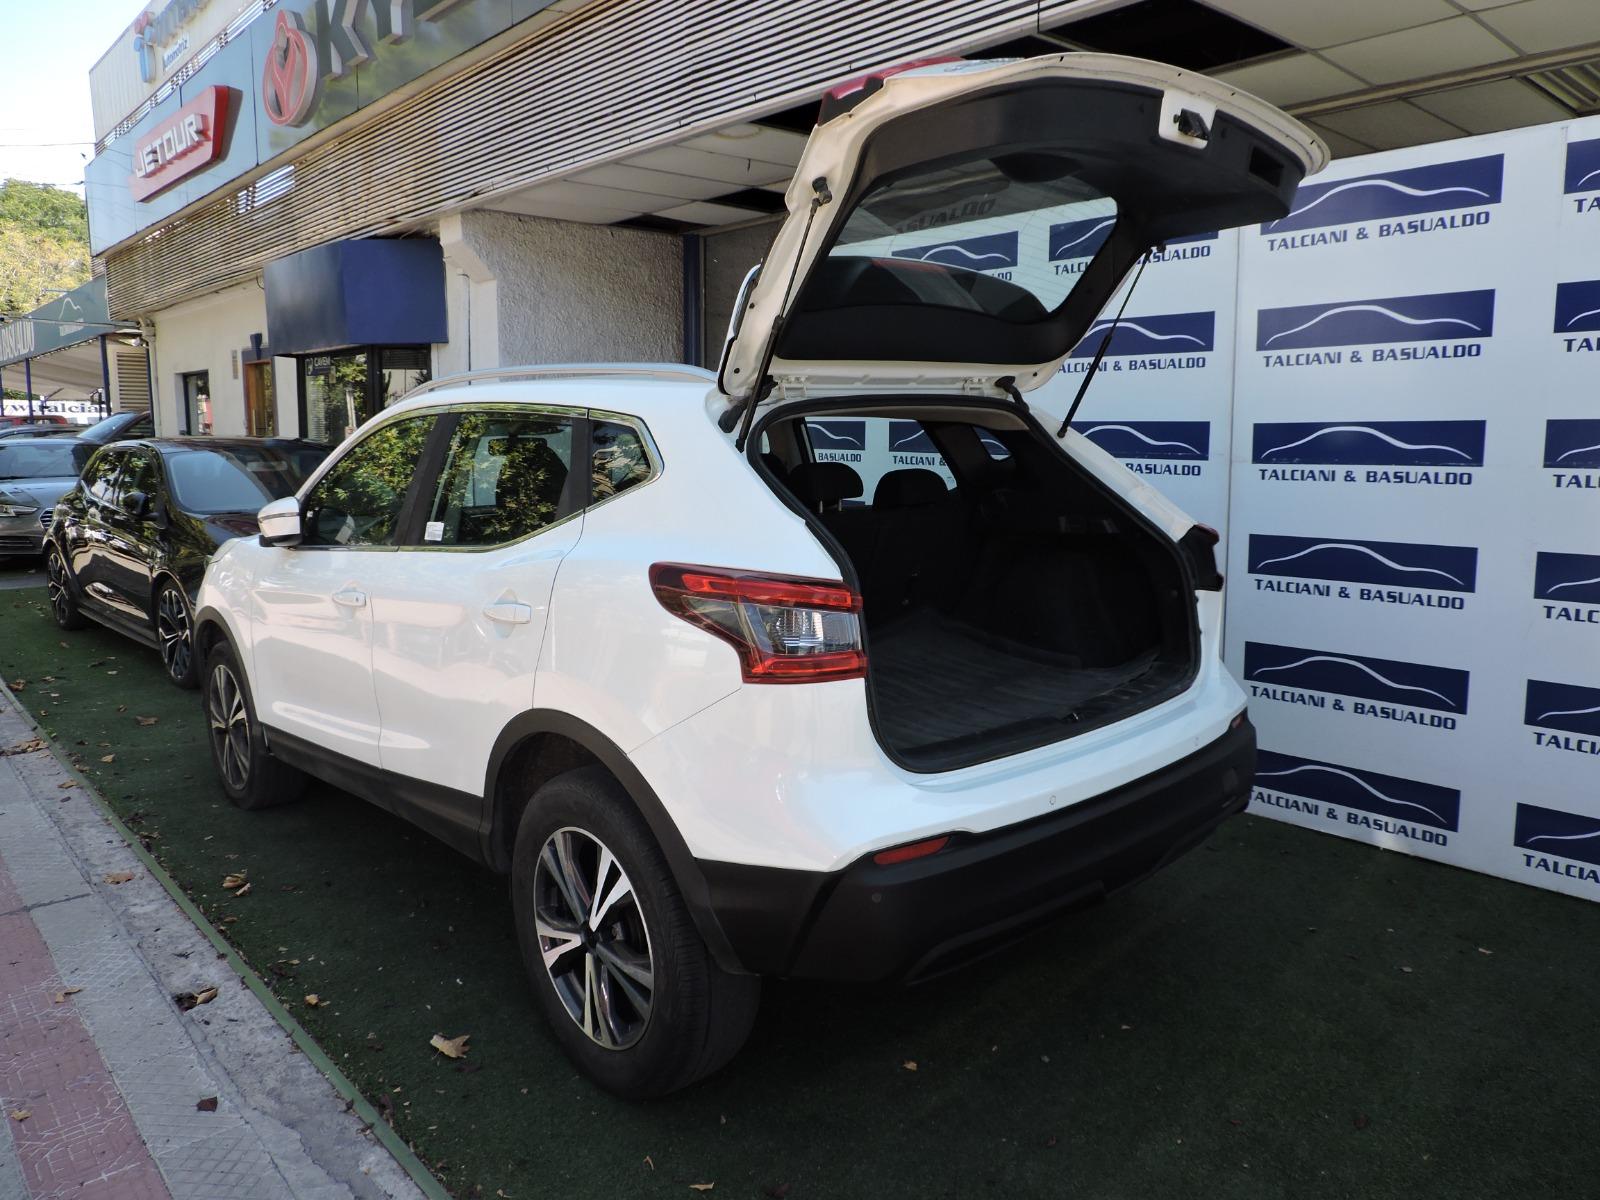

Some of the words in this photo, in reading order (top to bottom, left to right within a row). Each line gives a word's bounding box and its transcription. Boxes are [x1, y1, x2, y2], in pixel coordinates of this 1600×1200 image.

[136, 113, 200, 178] JETOUR
[1267, 229, 1348, 252] TALCIANI
[1355, 226, 1369, 241] &
[1378, 210, 1491, 237] BASUALDO
[1058, 361, 1108, 374] ALCIANI
[1113, 360, 1123, 372] &
[1129, 356, 1206, 371] BASUALDO
[1263, 350, 1342, 368] TALCIANI
[1349, 350, 1363, 364] &
[1372, 343, 1482, 363] BASUALDO
[818, 452, 862, 463] BASUALDO
[892, 455, 935, 466] TALCIANI
[1258, 468, 1336, 482] TALCIANI
[1343, 470, 1357, 483] &
[1365, 470, 1473, 485] BASUALDO
[1254, 578, 1331, 598] TALCIANI
[1338, 586, 1351, 599] &
[1359, 587, 1465, 610] BASUALDO
[1250, 684, 1326, 709] TALCIANI
[1332, 698, 1345, 712] &
[1353, 701, 1457, 730] BASUALDO
[1250, 788, 1319, 815] ALCIANI
[1326, 807, 1339, 821] &
[1346, 812, 1448, 847] BASUALDO
[1522, 853, 1600, 885] TALCIA
